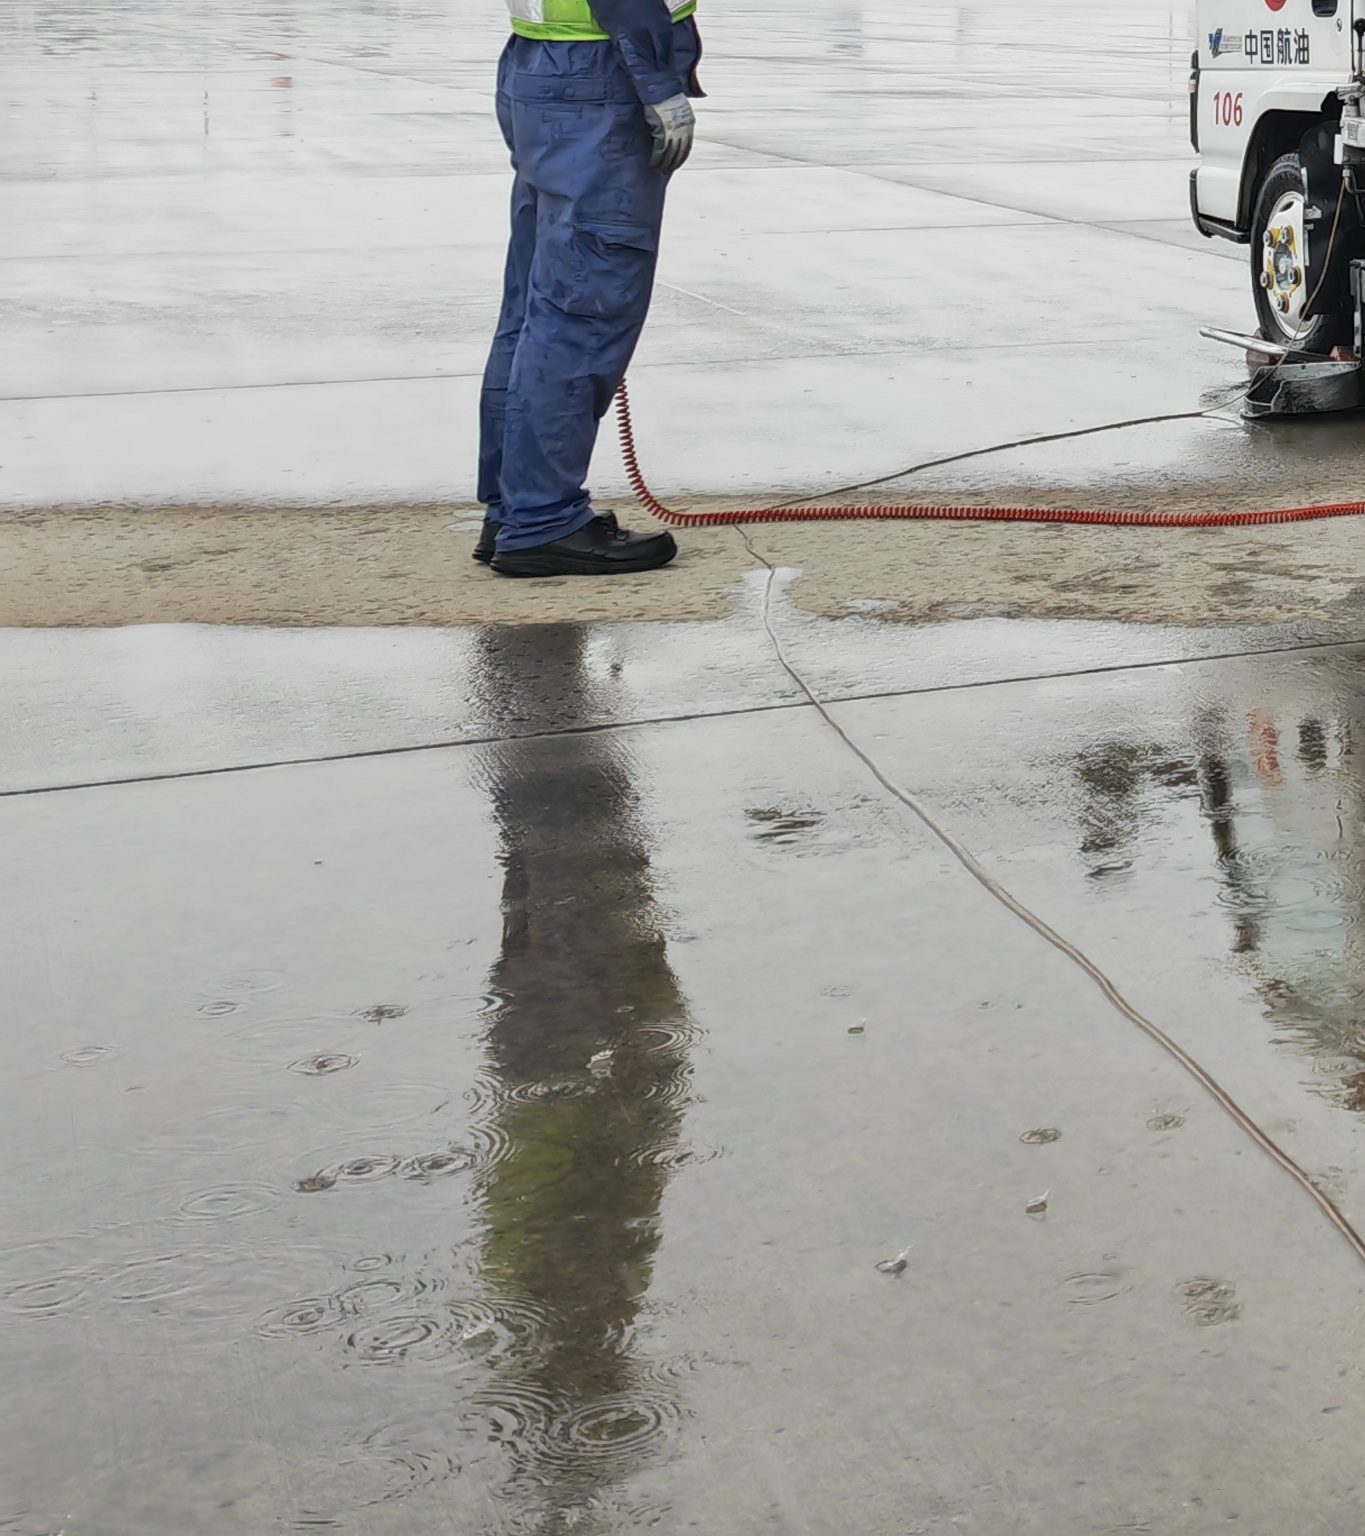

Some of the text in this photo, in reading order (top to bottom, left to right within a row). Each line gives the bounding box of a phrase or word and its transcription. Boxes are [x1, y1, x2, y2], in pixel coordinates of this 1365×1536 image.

[1244, 27, 1310, 65] 中国航油
[1213, 91, 1243, 127] 106
